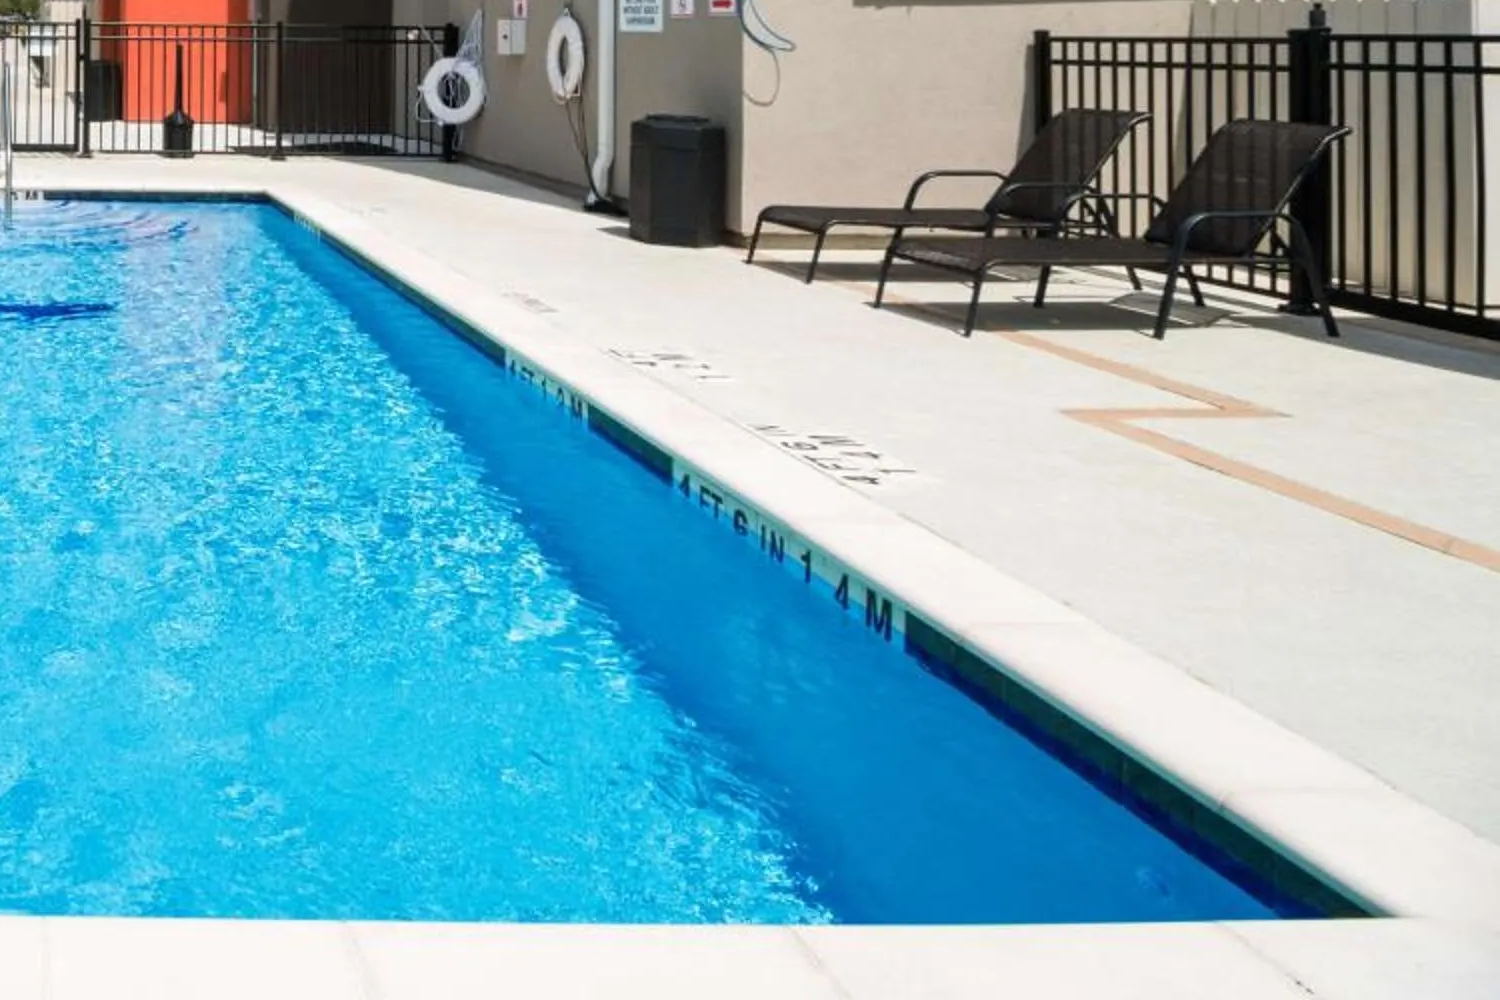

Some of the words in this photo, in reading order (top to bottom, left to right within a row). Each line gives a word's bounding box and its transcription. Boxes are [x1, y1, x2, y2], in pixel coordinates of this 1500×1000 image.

[700, 485, 724, 519] FT
[760, 523, 785, 563] IN
[865, 586, 893, 643] M
